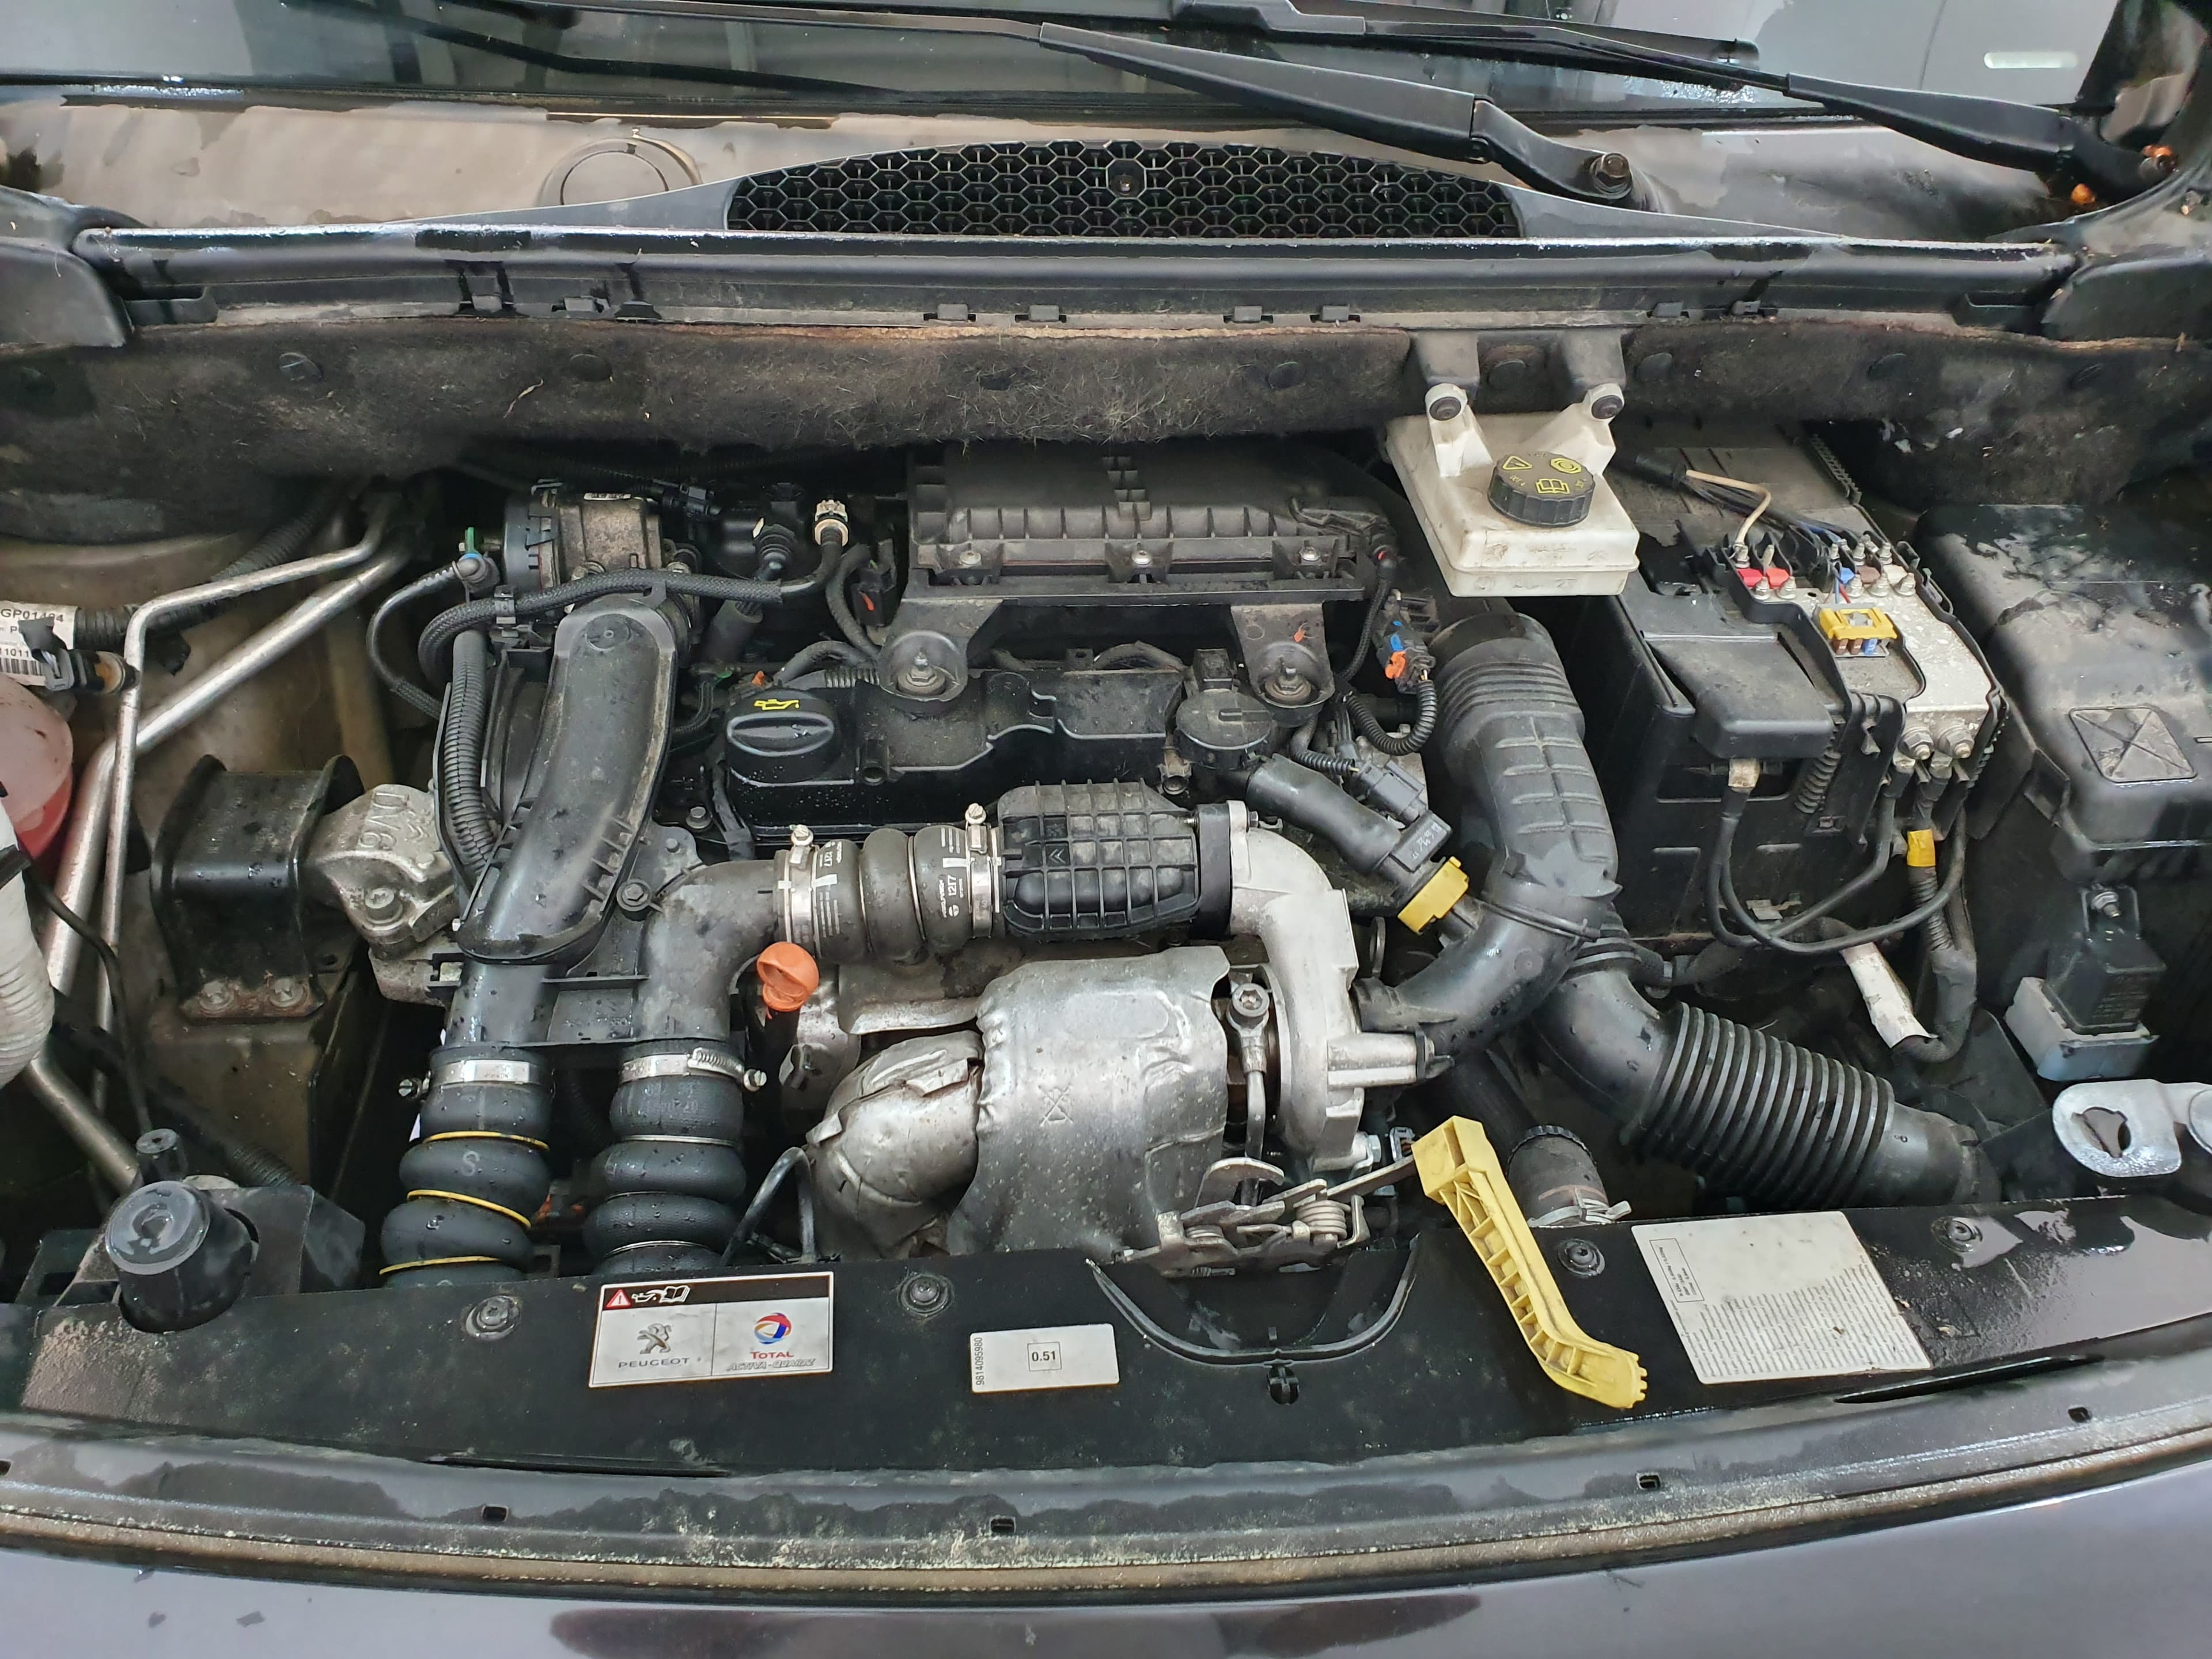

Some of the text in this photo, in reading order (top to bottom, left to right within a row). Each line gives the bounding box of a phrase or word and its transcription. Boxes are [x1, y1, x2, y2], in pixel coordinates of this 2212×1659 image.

[751, 1351, 795, 1359] TOTAL
[974, 1336, 985, 1385] 9814095980
[1031, 1350, 1056, 1362] 0.51
[618, 1357, 690, 1368] PEUGEOT
